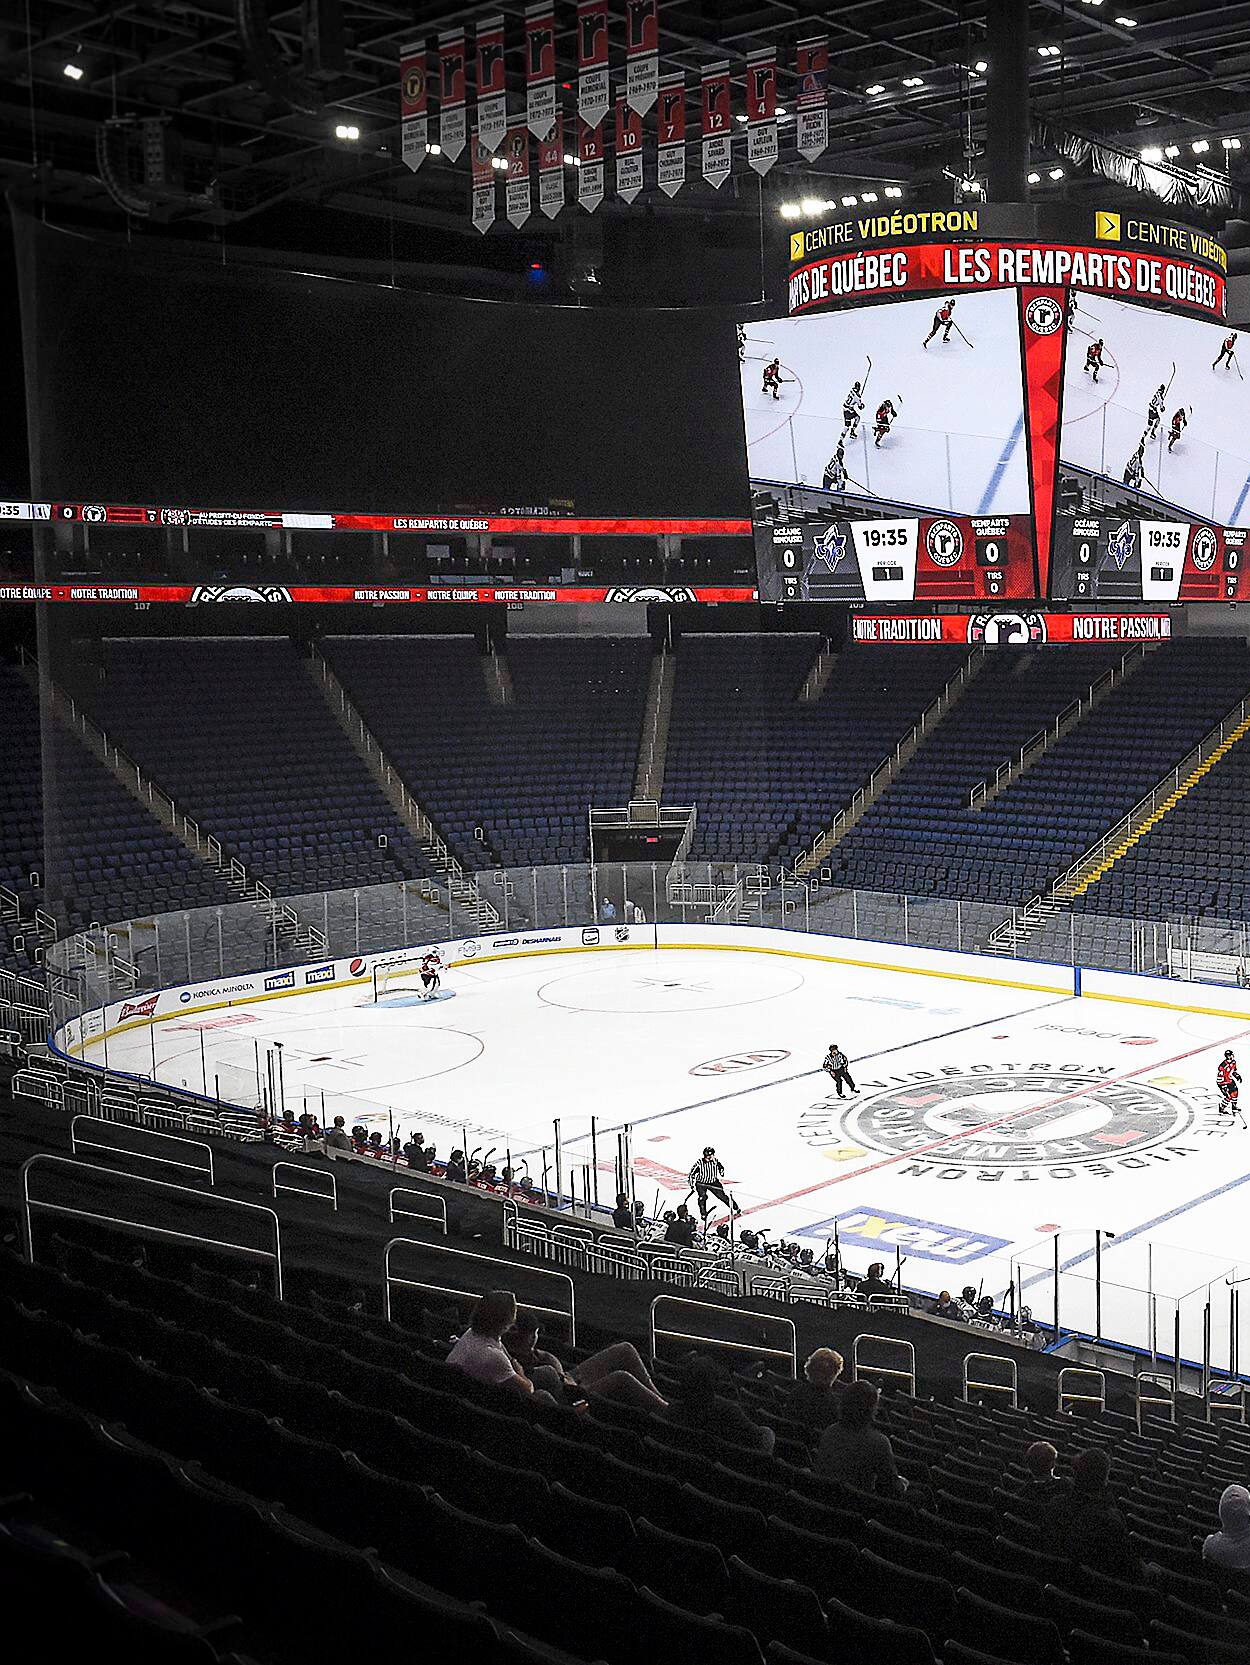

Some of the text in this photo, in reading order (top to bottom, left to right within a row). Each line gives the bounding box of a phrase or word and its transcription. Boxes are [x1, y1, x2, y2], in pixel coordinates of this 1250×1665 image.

[758, 102, 766, 114] 4
[709, 114, 723, 129] 12
[623, 133, 636, 146] 10
[667, 126, 674, 139] 7
[545, 151, 557, 163] 44
[584, 143, 596, 156] 12
[512, 162, 524, 175] 22
[805, 209, 978, 252] CENTRE VIDÉOTRON
[1127, 220, 1187, 250] CENTRE
[811, 251, 908, 301] DE QUÉBEC
[944, 248, 1216, 309] LES REMPARTS DE QUÉBEC
[63, 507, 73, 519] 0
[393, 518, 489, 530] LES REMPARTS DE QUÉBEC
[970, 519, 1010, 528] REMPARTS
[862, 529, 908, 546] 19:35
[975, 527, 1006, 536] QUÉBEC
[1148, 530, 1181, 548] 19:35
[783, 549, 795, 568] 0
[985, 542, 999, 563] 0
[1079, 543, 1090, 563] 0
[1228, 551, 1238, 569] 0
[884, 568, 890, 579] 1
[22, 585, 52, 599] ÉQUIPE
[70, 588, 138, 599] NOTRE TRADITION
[354, 590, 410, 600] NOTRE PASSION
[427, 589, 479, 600] NOTRE ÉQUIPE
[494, 590, 556, 600] NOTRE TRADITION
[787, 586, 795, 597] 0
[990, 582, 999, 593] 0
[1078, 582, 1086, 593] 0
[1227, 586, 1234, 596] 0
[134, 602, 151, 610] 107
[878, 618, 942, 640] TRADITION
[1073, 617, 1161, 641] NOTRE PASSION,
[265, 973, 293, 990] maxi
[306, 966, 334, 982] maxi
[193, 983, 255, 999] KONICA MINOLTA
[121, 1002, 158, 1018] Budweiser
[1033, 1023, 1121, 1039] pepsi
[700, 1053, 782, 1074] KIA
[860, 1061, 1117, 1088] VIDÉOTRON
[897, 1146, 1201, 1183] VIDÉOTRON
[813, 1212, 990, 1259] maxi
